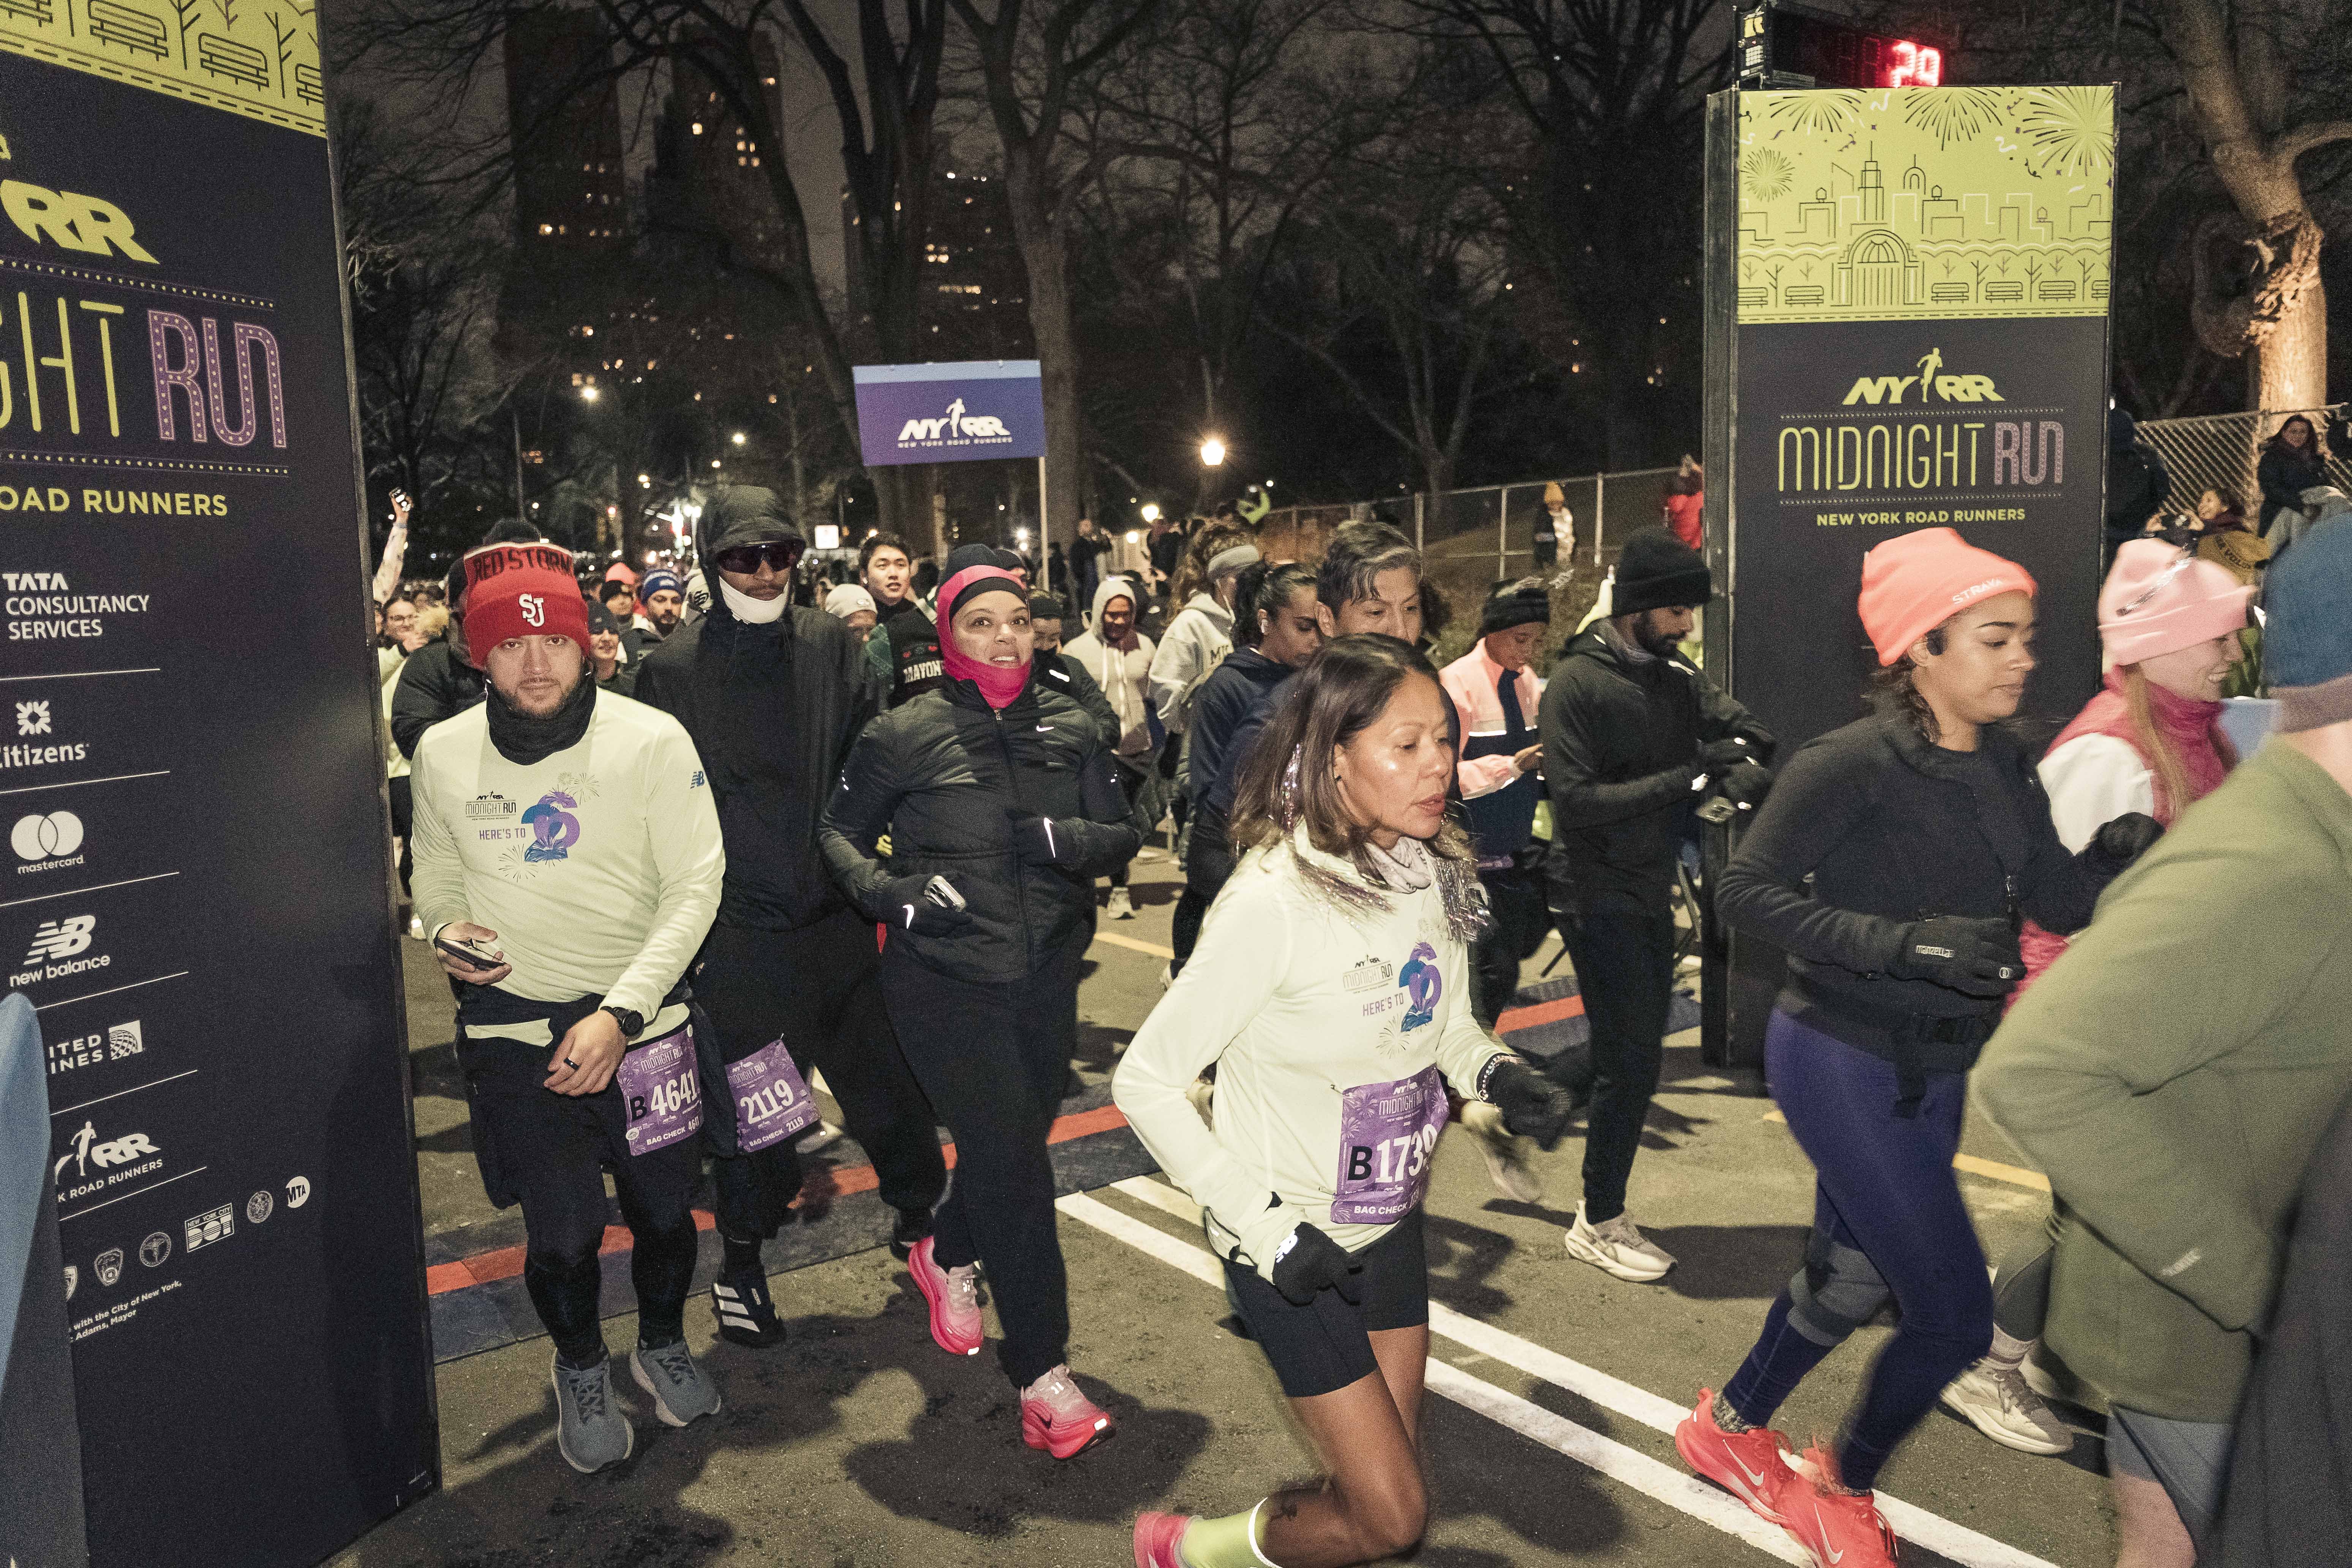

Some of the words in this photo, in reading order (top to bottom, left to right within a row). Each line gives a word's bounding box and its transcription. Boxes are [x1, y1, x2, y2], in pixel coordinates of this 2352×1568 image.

[0, 292, 124, 437] HT
[148, 310, 286, 448] RUN
[1842, 375, 2005, 405] NYRR
[898, 416, 1010, 441] NYRR
[1778, 423, 1985, 492] MIDNIGHT
[1993, 421, 2064, 485] RUN
[83, 489, 228, 516] RUNNERS
[1817, 513, 1854, 526] NEW
[1857, 512, 1901, 525] YORK
[1905, 511, 1949, 523] ROAD
[1954, 508, 2026, 522] RUNNERS
[473, 552, 503, 583] RED
[2, 573, 69, 591] TATA
[1952, 577, 2004, 604] STRAVA
[5, 595, 150, 616] CONSULTANCY
[518, 593, 545, 628] SJ
[8, 619, 103, 640] SERVICES
[0, 743, 86, 768] itizens
[466, 803, 501, 815] MIDNIGHT
[503, 802, 516, 814] RUN
[479, 828, 511, 840] HERE'S
[515, 828, 526, 838] TO
[17, 854, 84, 874] mastercard
[10, 969, 43, 987] new
[46, 955, 111, 979] balance
[1343, 967, 1380, 989] MIDNIGHT
[1381, 964, 1393, 979] RUN
[1363, 997, 1392, 1016] HERE'S
[1394, 992, 1404, 1006] TO
[49, 1035, 101, 1058] ITED
[51, 1049, 103, 1075] INES
[641, 1051, 673, 1072] MIDNIGHT
[754, 1062, 768, 1074] RUN
[630, 1095, 648, 1120] B
[651, 1068, 697, 1116] 4641
[740, 1079, 794, 1125] 2119
[1379, 1092, 1416, 1116] MIDNIGHT
[646, 1136, 662, 1145] BAG
[663, 1126, 686, 1140] CHECK
[688, 1115, 700, 1131] 4641
[749, 1138, 762, 1147] BAG
[762, 1129, 784, 1142] CHECK
[786, 1116, 804, 1132] 2119
[1347, 1146, 1373, 1181] B
[70, 1180, 104, 1198] ROAD
[108, 1159, 163, 1185] RUNNERS
[286, 1184, 306, 1203] MTA
[188, 1218, 200, 1228] NEW
[202, 1212, 217, 1222] YORK
[219, 1206, 231, 1216] CITY
[1354, 1205, 1376, 1214] BAG
[1378, 1202, 1408, 1215] CHECK
[74, 1317, 93, 1330] with
[95, 1310, 110, 1321] the
[111, 1302, 128, 1315] City
[130, 1296, 140, 1307] of
[141, 1289, 159, 1302] New
[161, 1280, 182, 1293] York,
[76, 1322, 109, 1341] Adams,
[111, 1309, 137, 1325] Mayor
